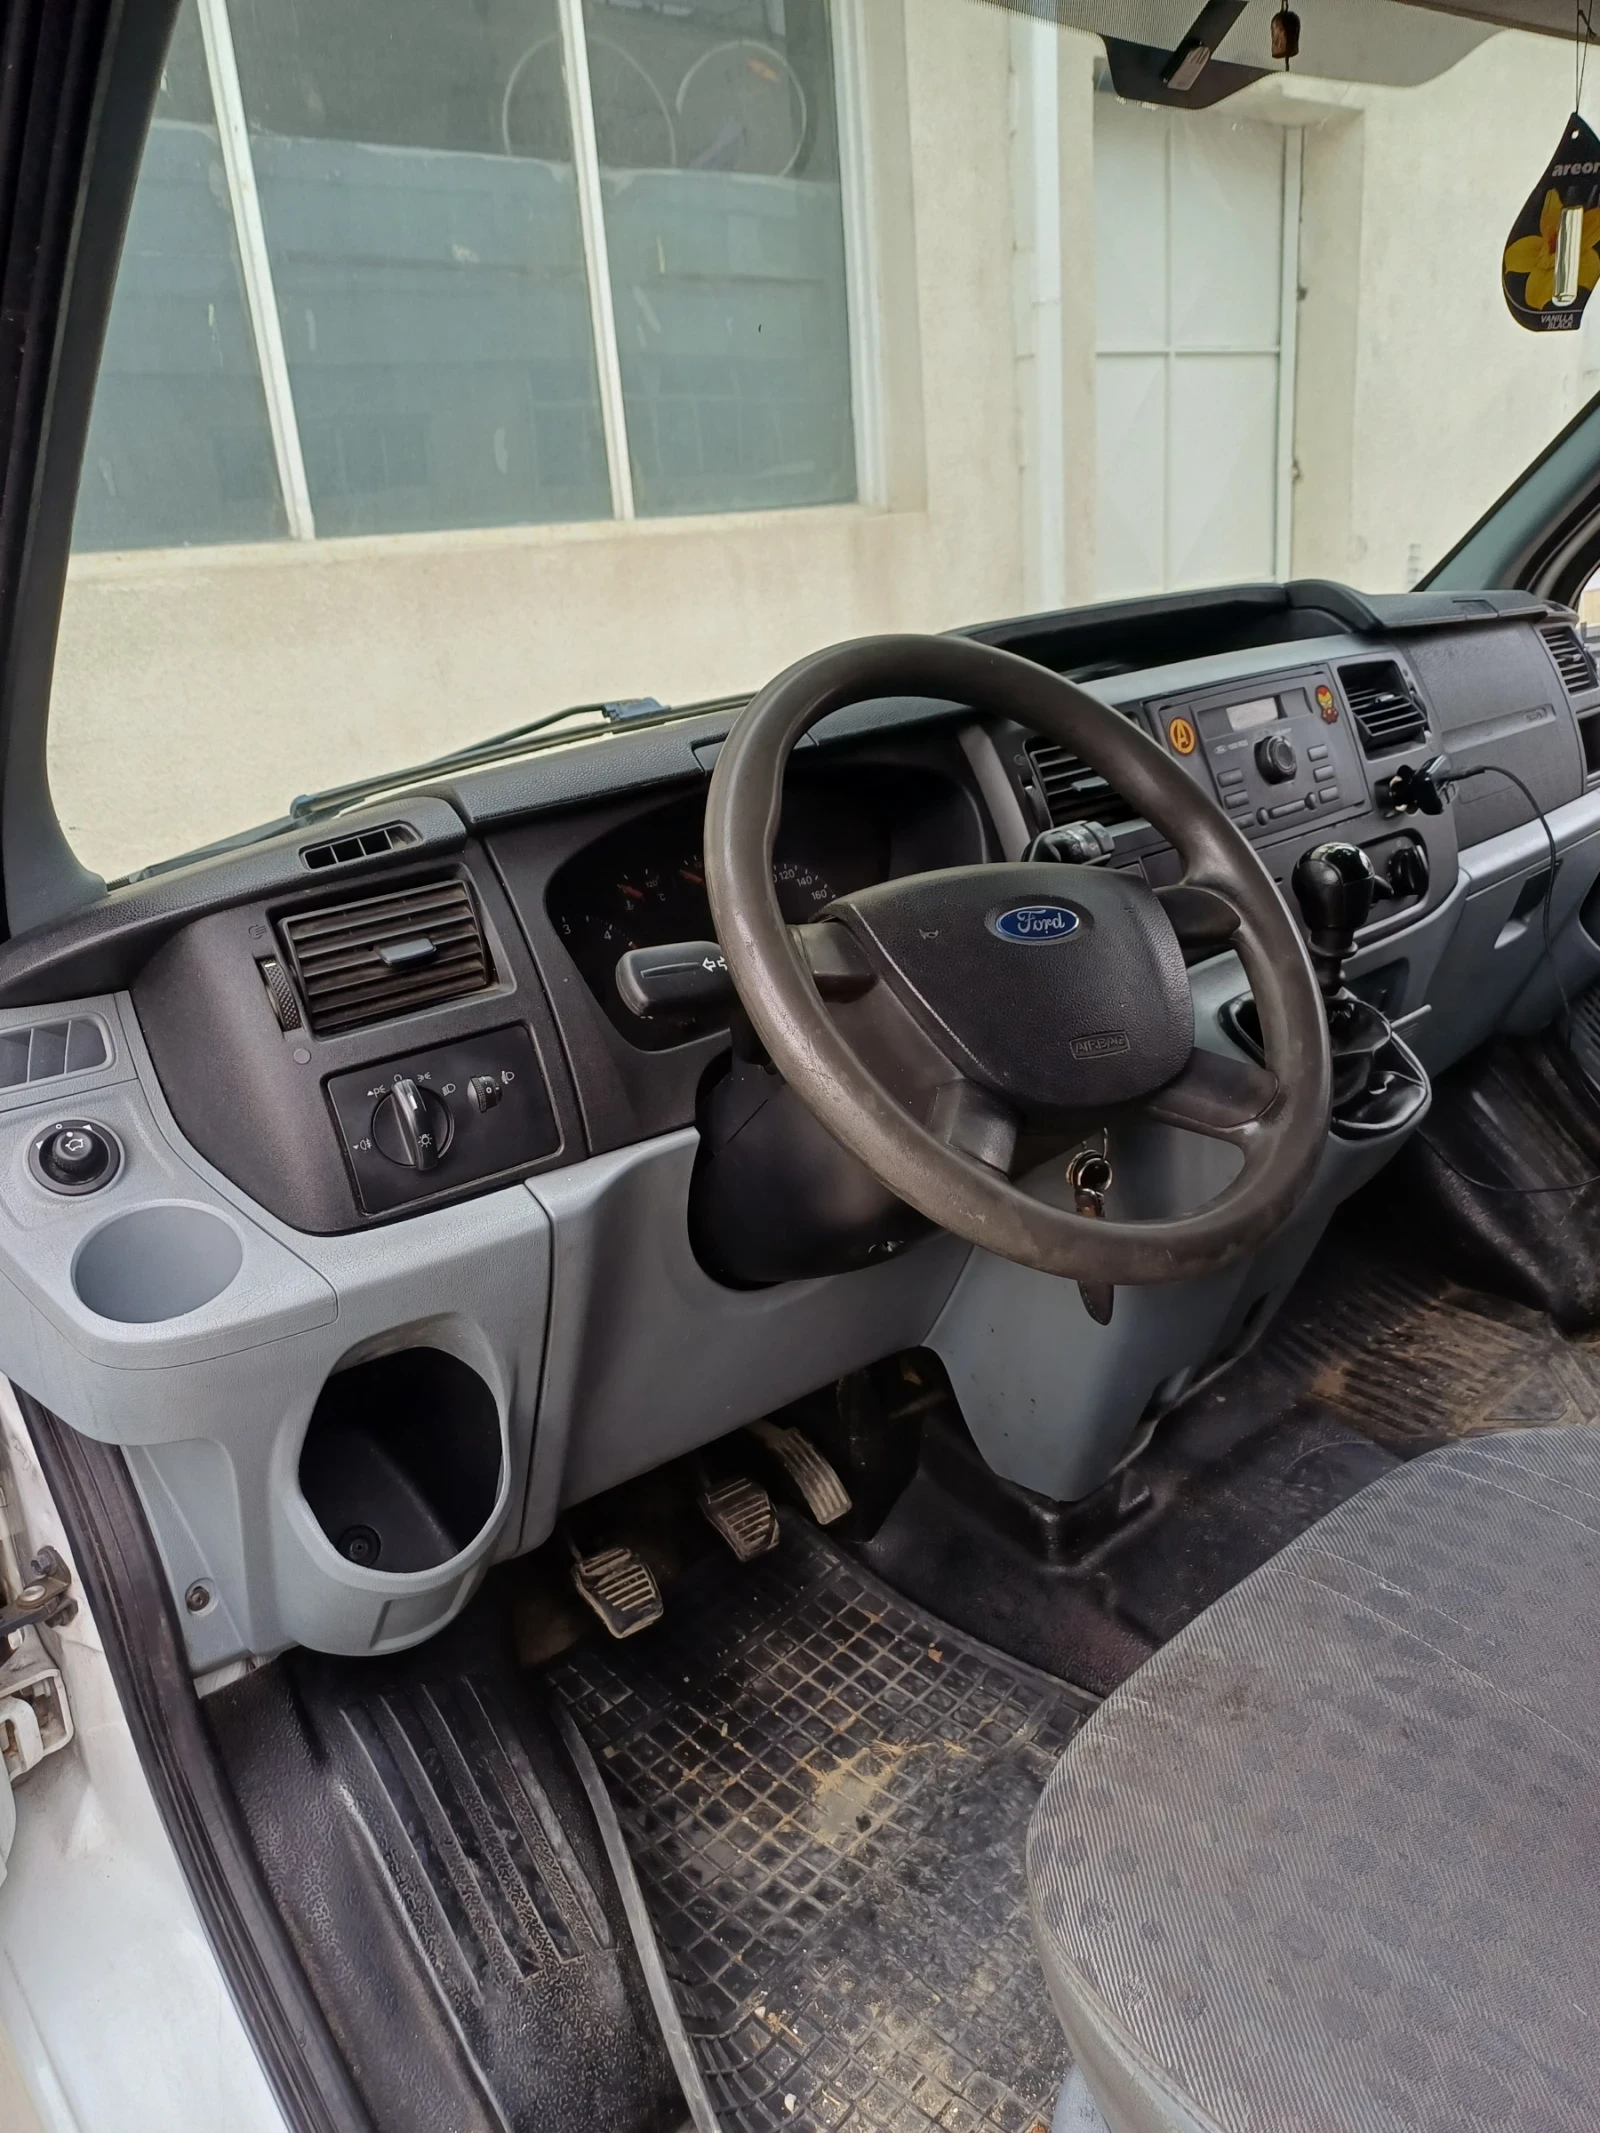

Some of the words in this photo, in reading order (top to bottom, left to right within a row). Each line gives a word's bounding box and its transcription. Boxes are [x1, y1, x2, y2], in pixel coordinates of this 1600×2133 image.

[1541, 313, 1573, 324] VANILLA
[1547, 320, 1573, 330] BLACK
[779, 869, 795, 880] 120
[796, 875, 812, 887] 140
[811, 889, 827, 900] 160
[1017, 910, 1065, 933] Ford
[563, 924, 571, 935] 3
[603, 930, 612, 940] 4
[1075, 1034, 1126, 1055] AIRBAG
